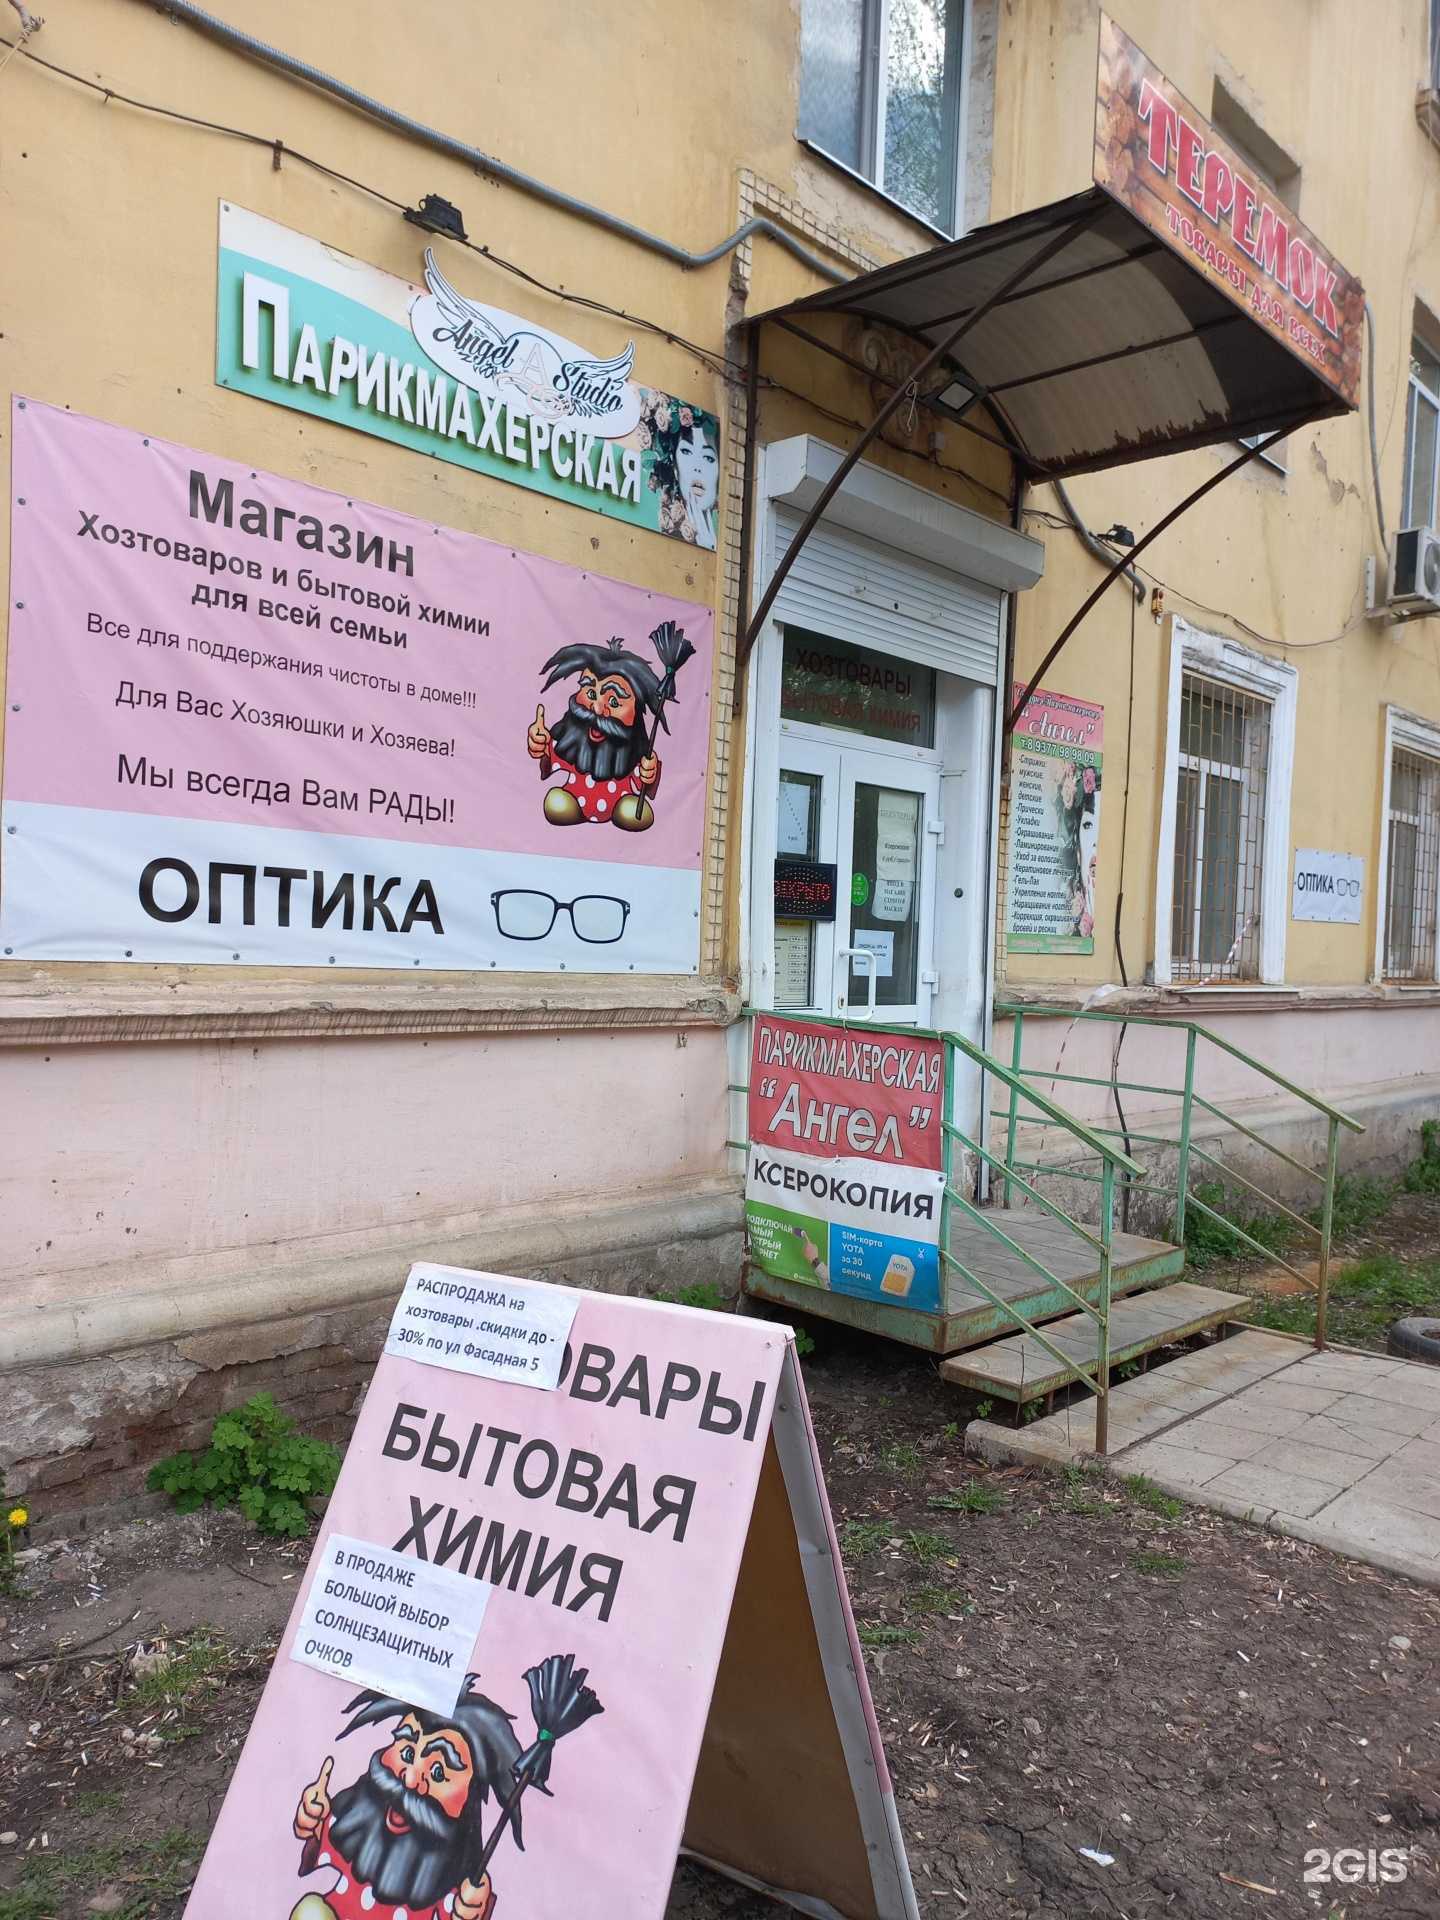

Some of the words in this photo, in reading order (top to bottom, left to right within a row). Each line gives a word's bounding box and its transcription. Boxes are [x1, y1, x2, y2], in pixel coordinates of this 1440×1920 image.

[1138, 77, 1339, 338] ТЕРЕМОК
[1166, 203, 1246, 296] ТОВАРЫ
[1289, 315, 1327, 366] ВСЕХ
[241, 271, 642, 504] ПАРИКМАХЕРСКАЯ
[432, 318, 520, 368] Angel
[553, 362, 624, 412] Studio
[188, 469, 416, 577] Магазин
[77, 511, 263, 581] Хозтоваров
[271, 566, 289, 588] и
[297, 568, 411, 618] бытовой
[417, 603, 492, 637] химии
[191, 583, 249, 613] для
[258, 597, 322, 629] всей
[329, 613, 409, 649] семьи
[86, 612, 131, 640] Все
[137, 627, 180, 650] для
[187, 637, 324, 679] поддержания
[328, 666, 401, 695] чистоты
[406, 681, 417, 696] в
[420, 681, 478, 709] доме!!!
[115, 680, 168, 710] Для
[176, 690, 224, 719] Вас
[230, 698, 346, 740] Хозяюшки
[352, 725, 364, 742] и
[370, 723, 457, 758] Хозяева!
[117, 753, 175, 789] Мы
[187, 771, 291, 807] всегда
[302, 778, 360, 812] Вам
[369, 788, 457, 825] РАДЫ!
[138, 856, 446, 936] ОПТИКА
[1297, 871, 1335, 894] ОПТИКА
[758, 1026, 942, 1095] ПАРИКМАХЕРСКАЯ
[759, 1077, 933, 1159] “Ангел”
[754, 1158, 934, 1221] КСЕРОКОПИЯ
[841, 1244, 865, 1256] YOTA
[852, 1257, 863, 1268] 30
[405, 1304, 474, 1329] хозтовары
[475, 1319, 527, 1340] .скидки
[528, 1332, 548, 1345] до
[416, 1278, 507, 1307] РАСПРОДАЖА
[508, 1299, 526, 1311] на
[397, 1328, 424, 1346] 30%
[426, 1336, 443, 1350] по
[445, 1340, 461, 1355] ул
[463, 1342, 528, 1369] Фасадная
[530, 1357, 541, 1372] 5
[381, 1402, 697, 1544] БЫТОВАЯ
[334, 1550, 345, 1566] В
[346, 1554, 416, 1588] ПРОДАЖЕ
[392, 1494, 625, 1623] ХИМИЯ
[315, 1608, 455, 1669] СОЛНЦЕЗАЩИТНЫХ
[324, 1579, 397, 1616] БОЛЬШОЙ
[398, 1602, 450, 1632] ВЫБОР
[304, 1639, 353, 1668] ОЧКОВ
